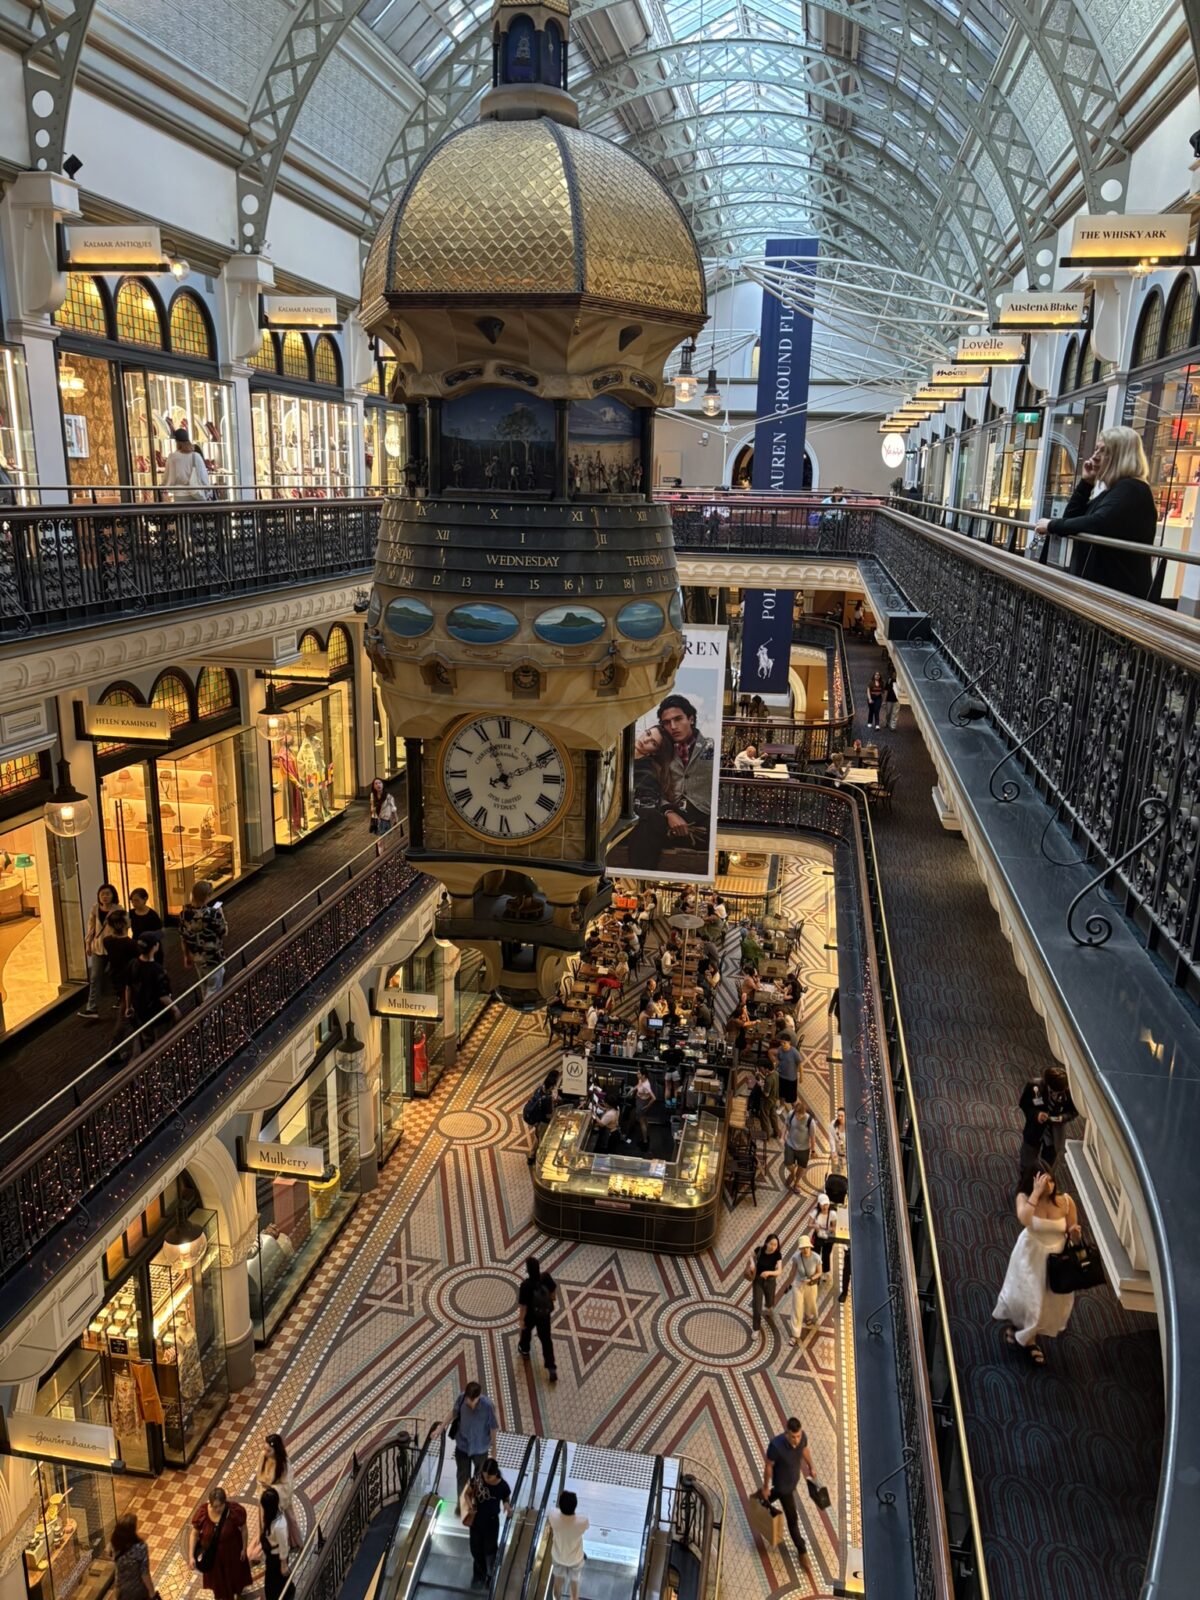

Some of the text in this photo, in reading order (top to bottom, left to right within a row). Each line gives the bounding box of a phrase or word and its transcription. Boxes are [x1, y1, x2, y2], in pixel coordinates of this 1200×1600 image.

[1080, 230, 1167, 239] THE WHISKY ARK
[115, 241, 152, 249] ANTIQUES
[775, 338, 792, 414] GROUND
[486, 554, 560, 567] WEDNESDAY
[432, 575, 441, 585] 12
[462, 577, 471, 587] 13
[494, 579, 504, 589] 14
[530, 579, 540, 590] 15
[564, 579, 574, 590] 16
[595, 579, 604, 589] 17
[624, 578, 632, 589] 18
[96, 717, 157, 728] HELEN KAMINSKI
[388, 998, 426, 1012] Mulberry
[259, 1150, 309, 1170] Mulberry
